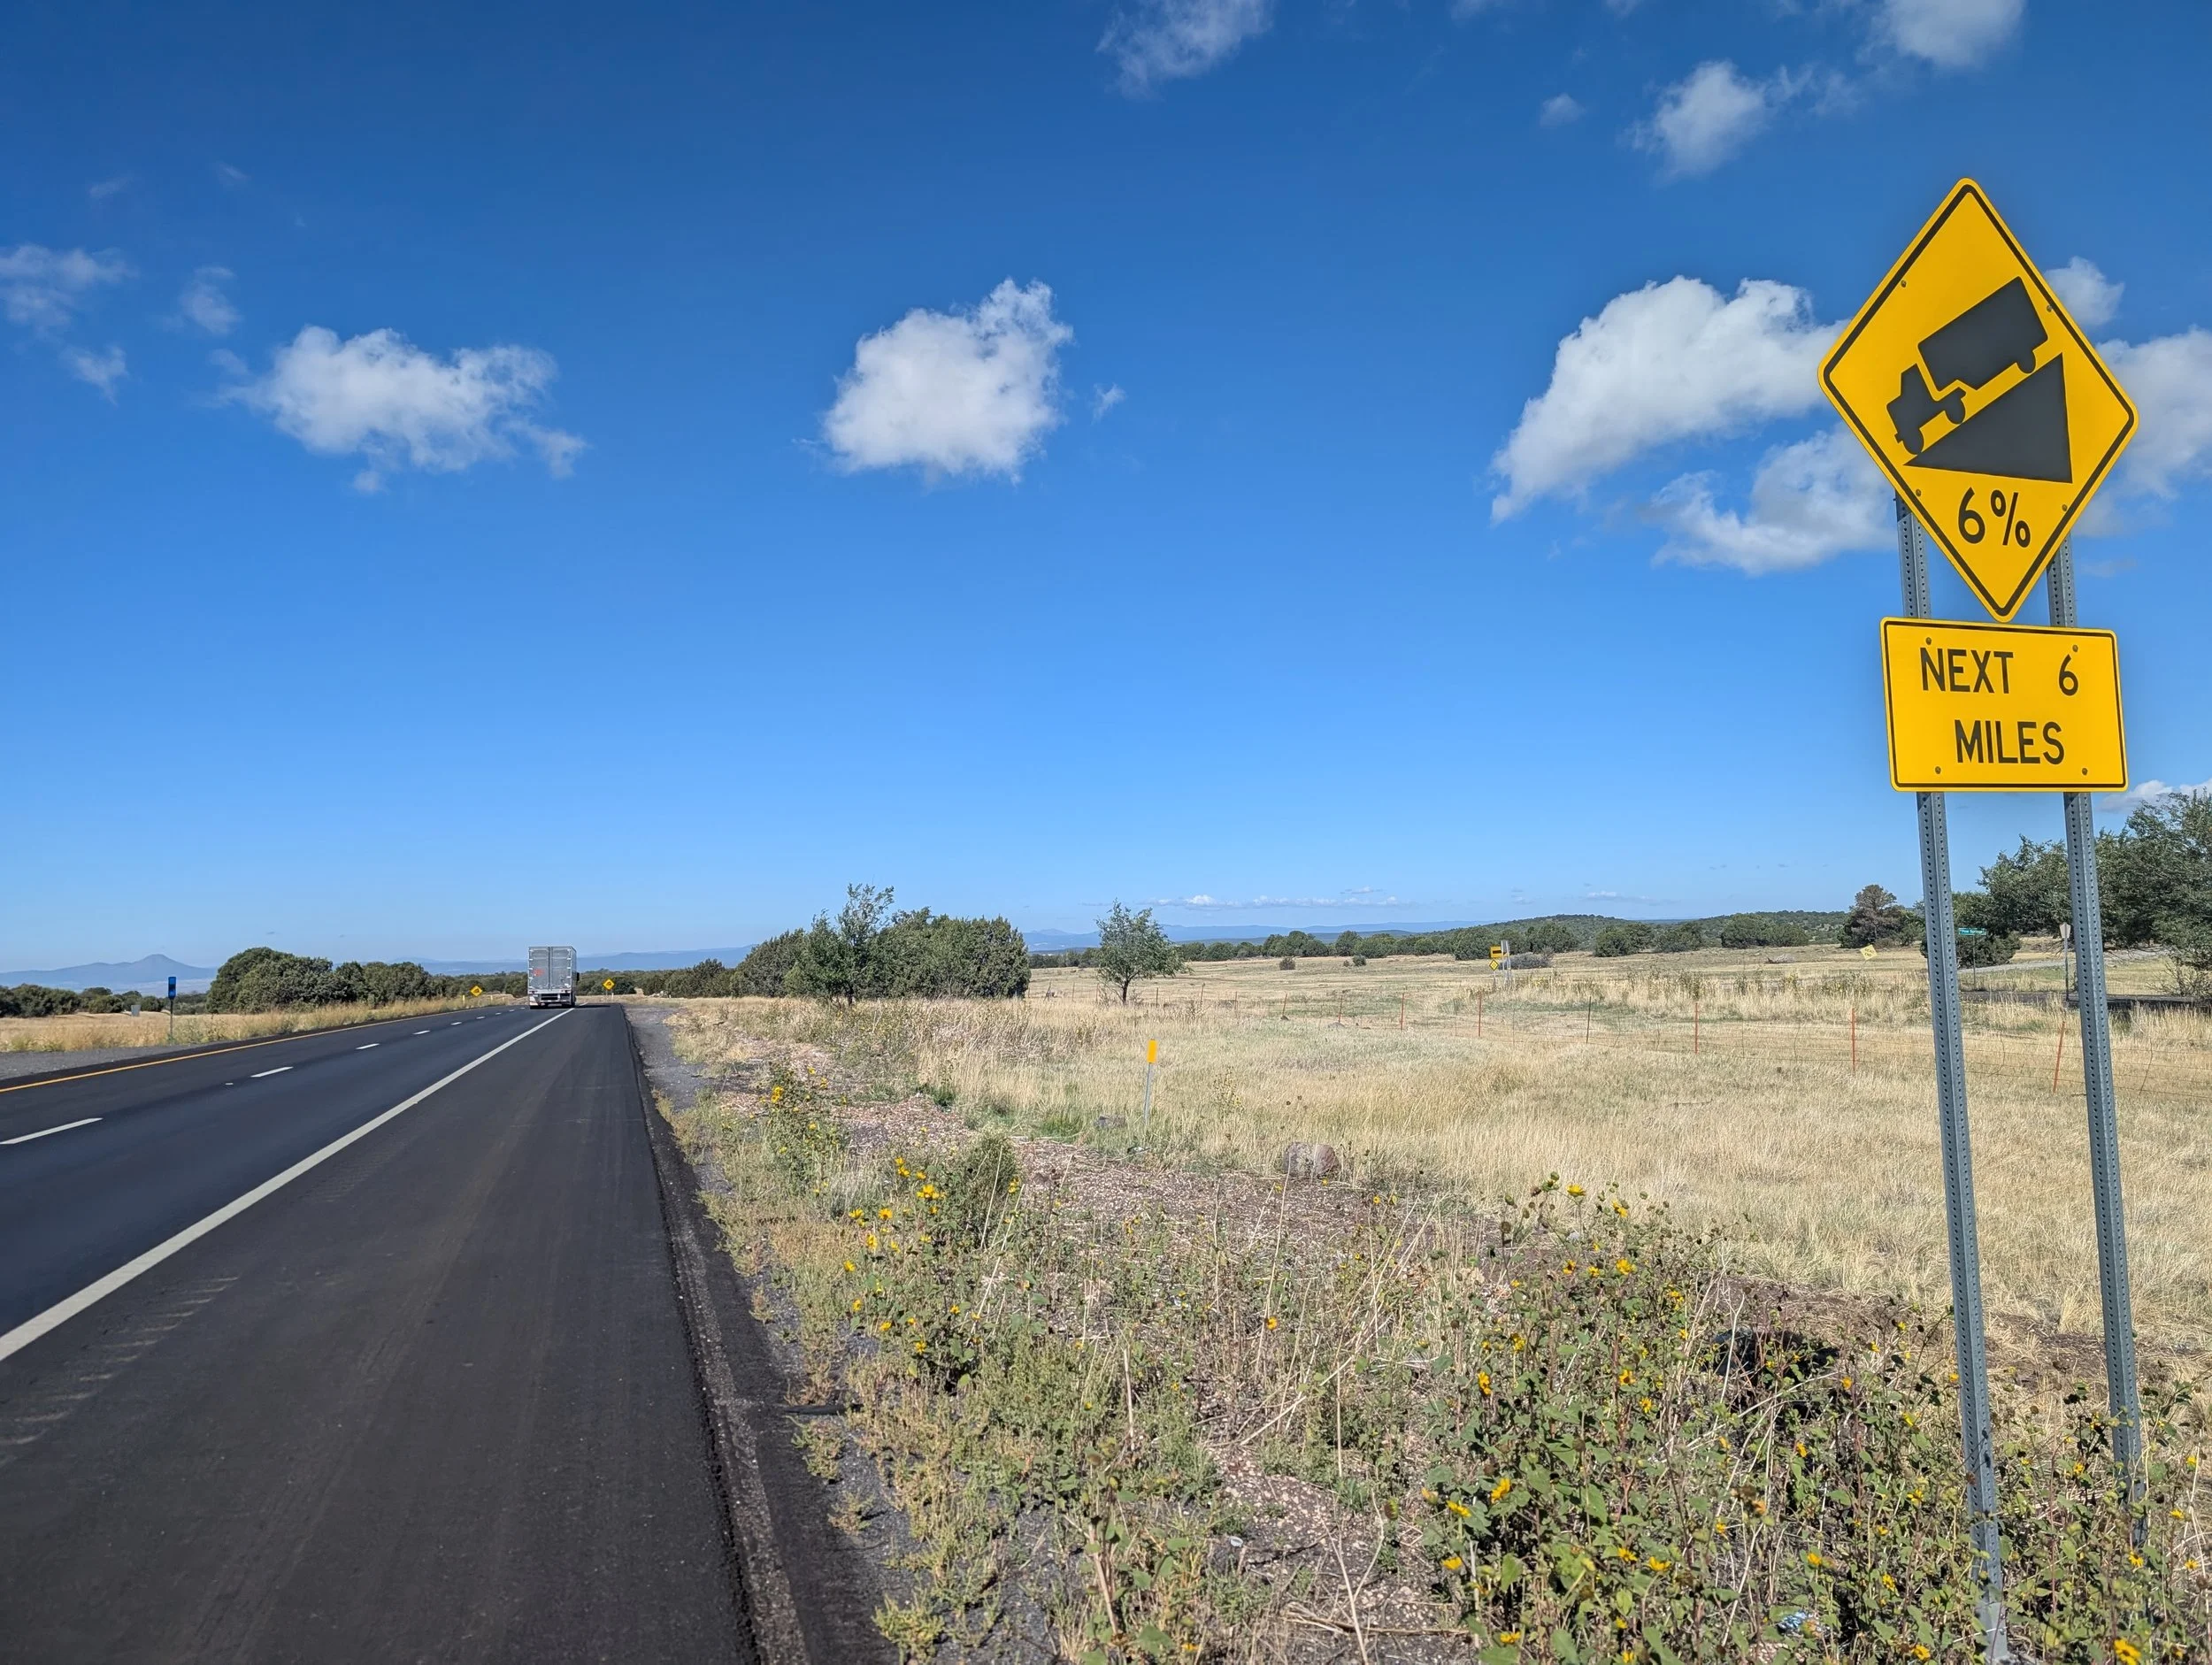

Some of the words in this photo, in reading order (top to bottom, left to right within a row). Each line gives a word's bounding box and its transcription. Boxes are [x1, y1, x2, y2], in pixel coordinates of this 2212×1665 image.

[1958, 487, 2031, 549] 6%
[1920, 647, 2014, 694] NEXT
[2058, 654, 2078, 696] 6
[1955, 719, 2064, 765] MILES
